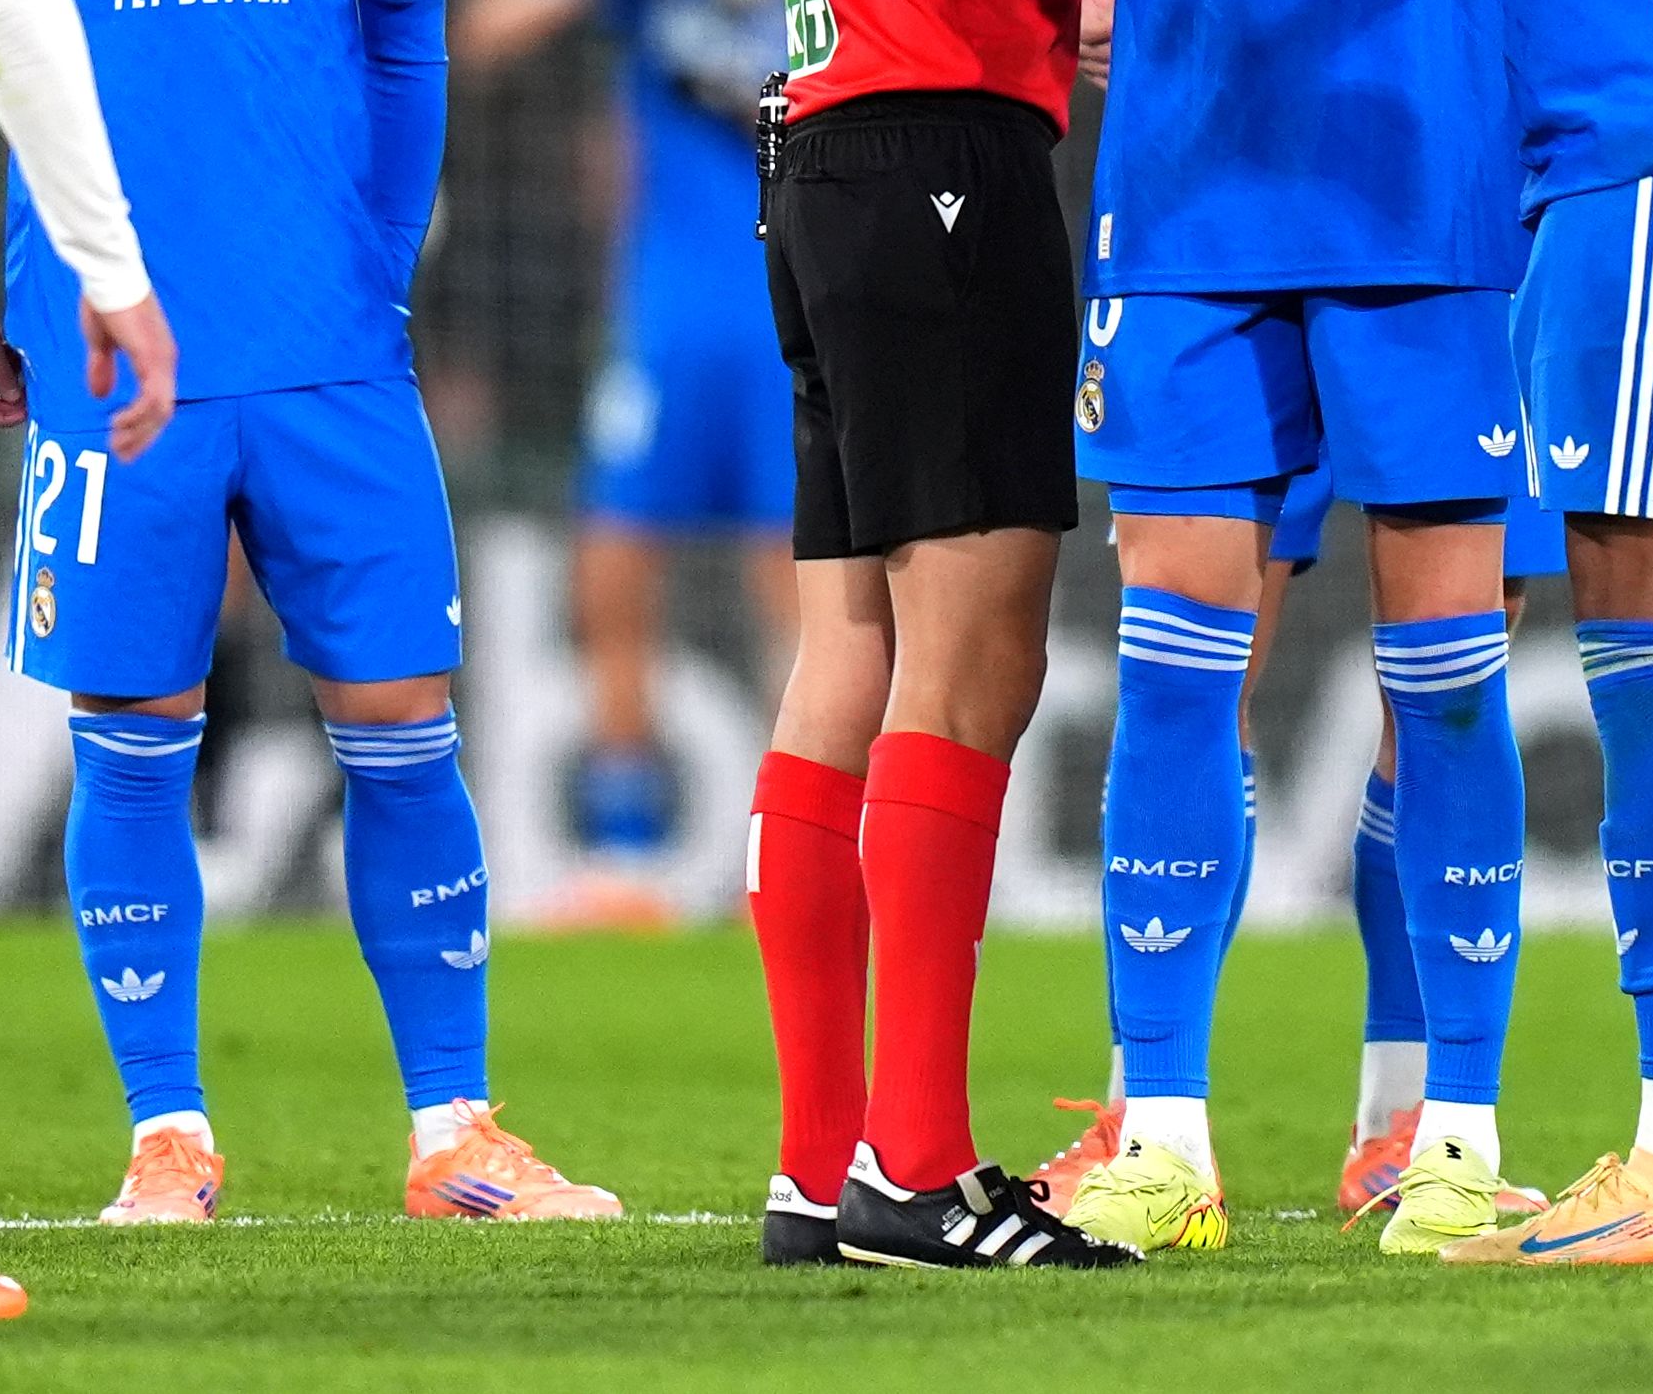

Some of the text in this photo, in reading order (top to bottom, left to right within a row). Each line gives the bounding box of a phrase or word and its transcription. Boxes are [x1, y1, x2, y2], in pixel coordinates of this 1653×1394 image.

[31, 439, 109, 565] 21
[1109, 855, 1219, 879] RMCF
[410, 867, 488, 909] RMC
[81, 903, 169, 929] RMCF
